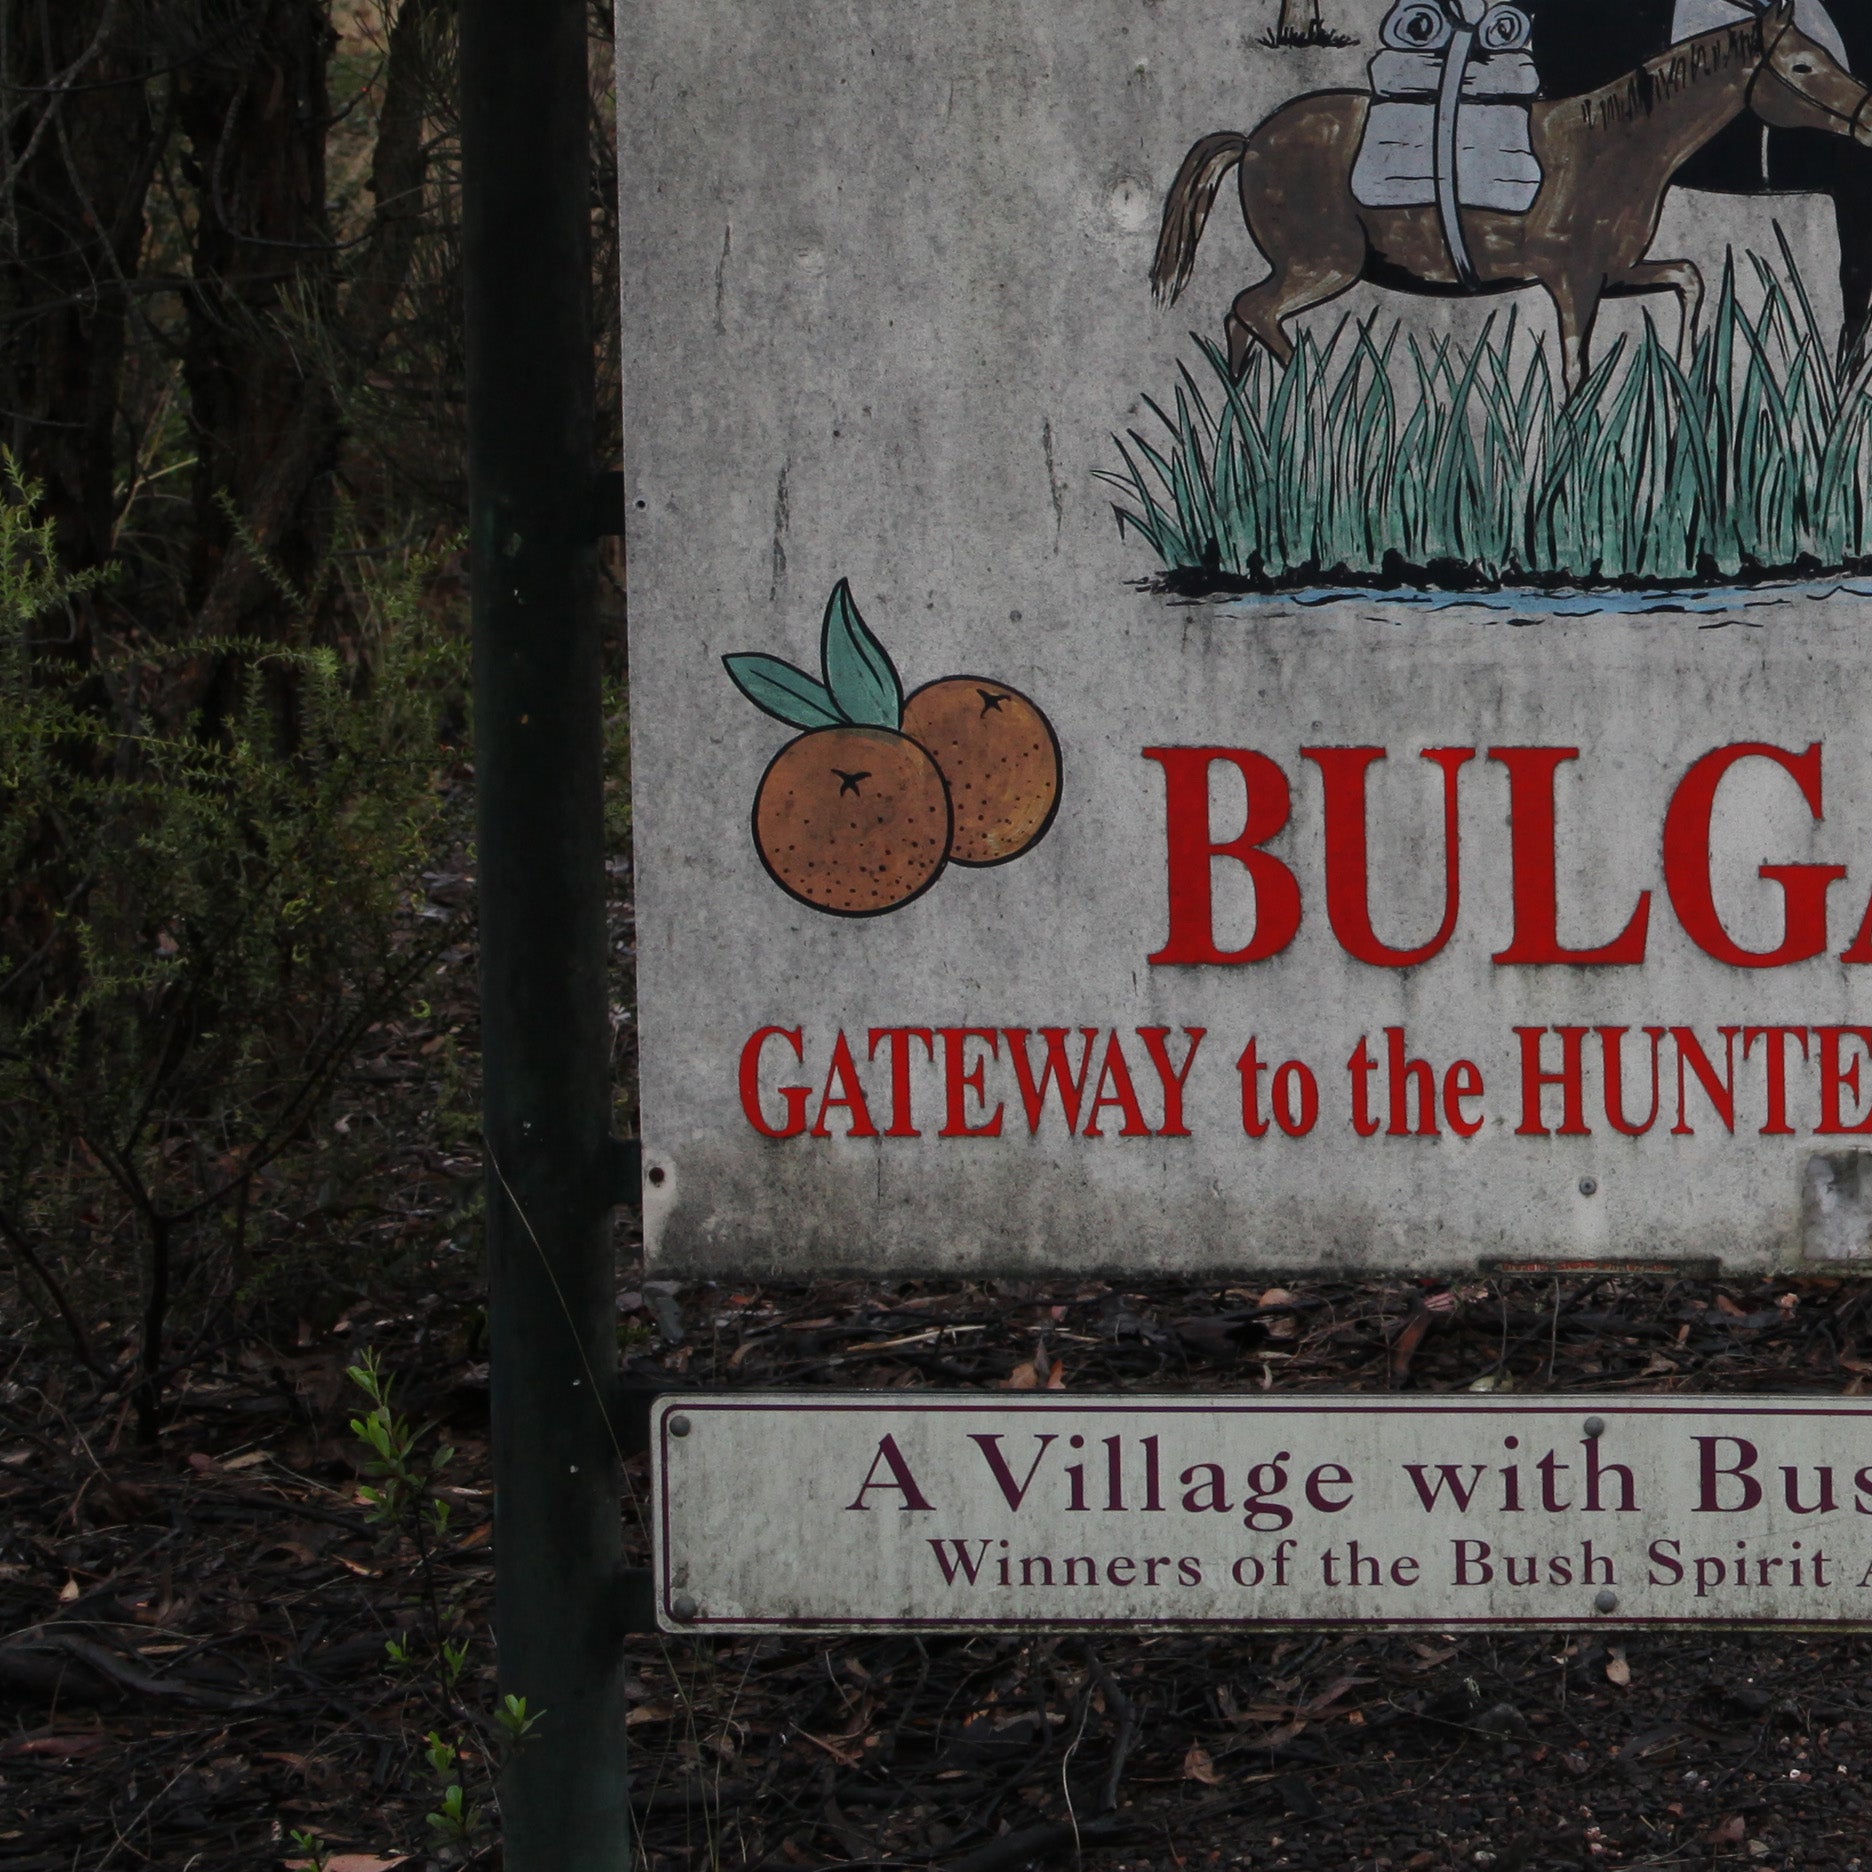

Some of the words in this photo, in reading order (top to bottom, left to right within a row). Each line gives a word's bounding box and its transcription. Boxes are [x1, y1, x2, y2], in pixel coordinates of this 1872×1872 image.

[738, 1025, 1206, 1138] GATEWAY
[1237, 1039, 1319, 1138] to
[1347, 1026, 1485, 1138] the
[845, 1433, 936, 1513] A
[966, 1432, 1354, 1533] Village
[1401, 1432, 1642, 1514] with
[925, 1538, 1202, 1588] Winners
[1231, 1539, 1298, 1588] of
[1320, 1539, 1420, 1588] the
[1450, 1539, 1620, 1588] Bush
[1648, 1539, 1833, 1598] Spirit
